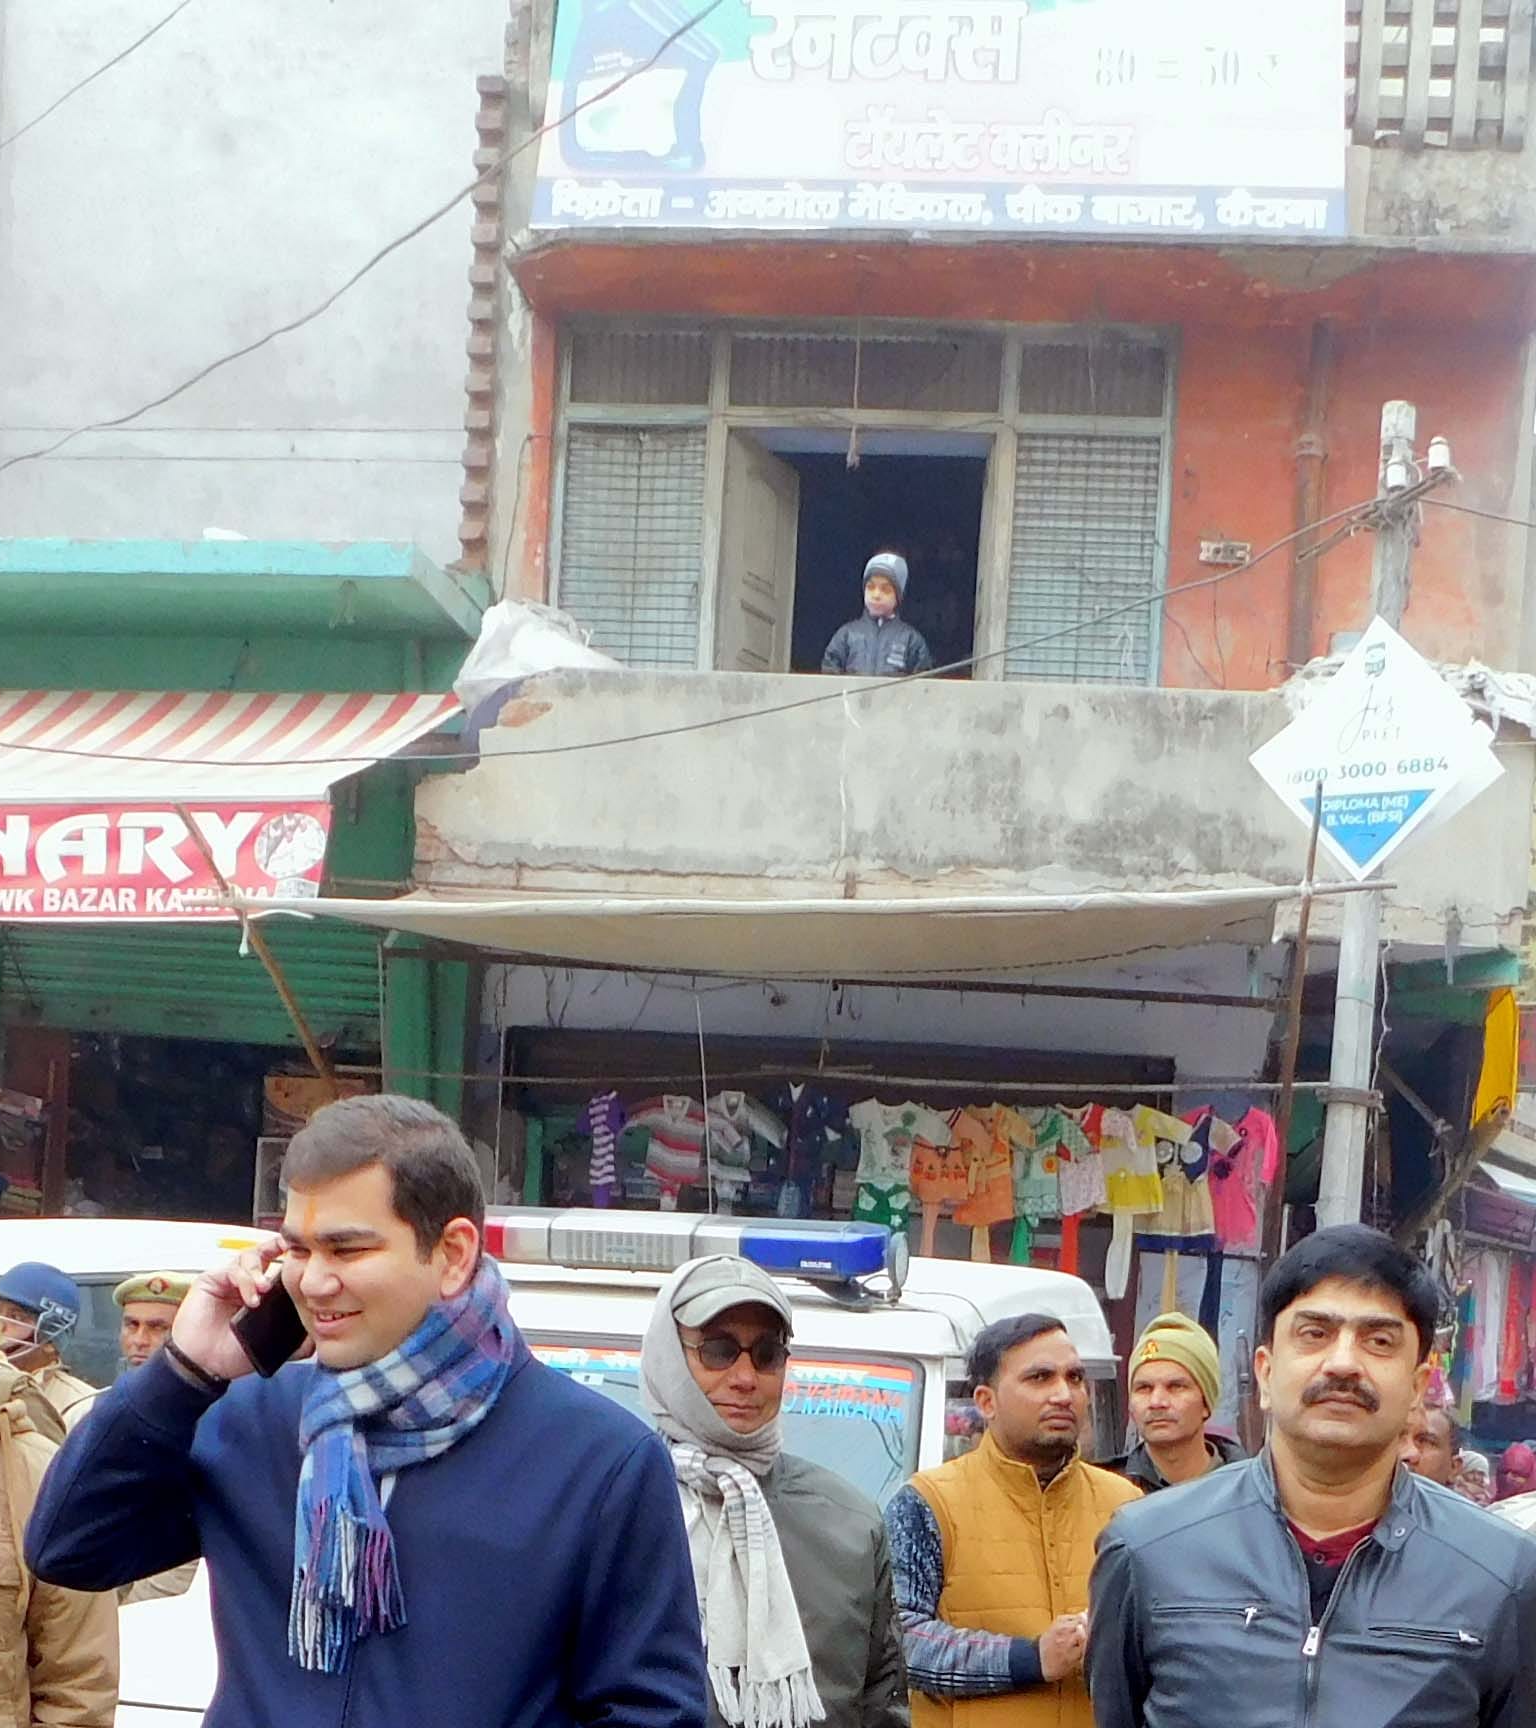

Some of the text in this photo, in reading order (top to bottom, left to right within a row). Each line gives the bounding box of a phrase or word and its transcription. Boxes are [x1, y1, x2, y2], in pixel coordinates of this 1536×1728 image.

[1396, 756, 1449, 774] 6884
[43, 888, 139, 912] BAZAR
[802, 1384, 904, 1424] KAIRANA
